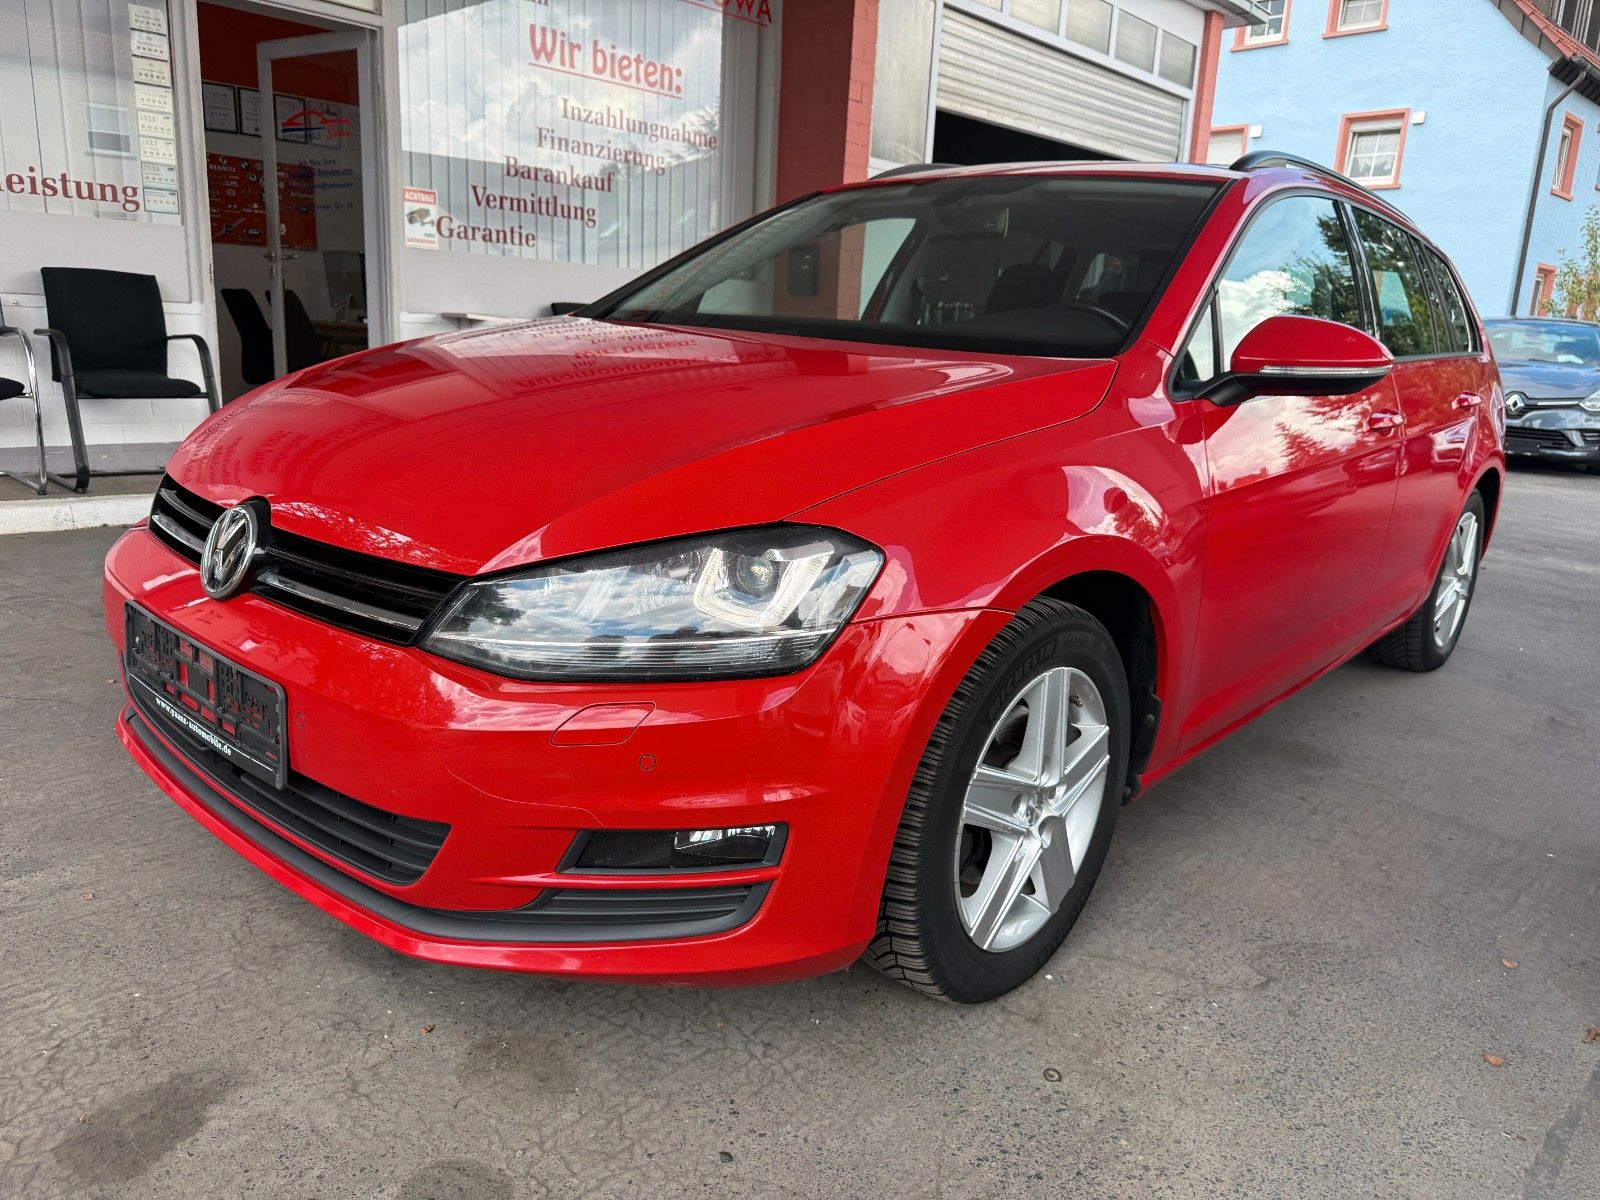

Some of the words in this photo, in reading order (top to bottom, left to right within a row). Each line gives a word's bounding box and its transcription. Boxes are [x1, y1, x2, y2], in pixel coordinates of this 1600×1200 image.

[529, 23, 581, 69] Wir
[591, 38, 682, 94] bieten:
[561, 97, 718, 151] Inzahlungnahme
[504, 155, 614, 193] Barankauf
[536, 127, 665, 176] Finanzierung
[0, 166, 140, 213] eistung
[404, 191, 435, 203] ACHTUNG
[471, 185, 596, 228] Vermittlung
[436, 215, 536, 248] Garantie
